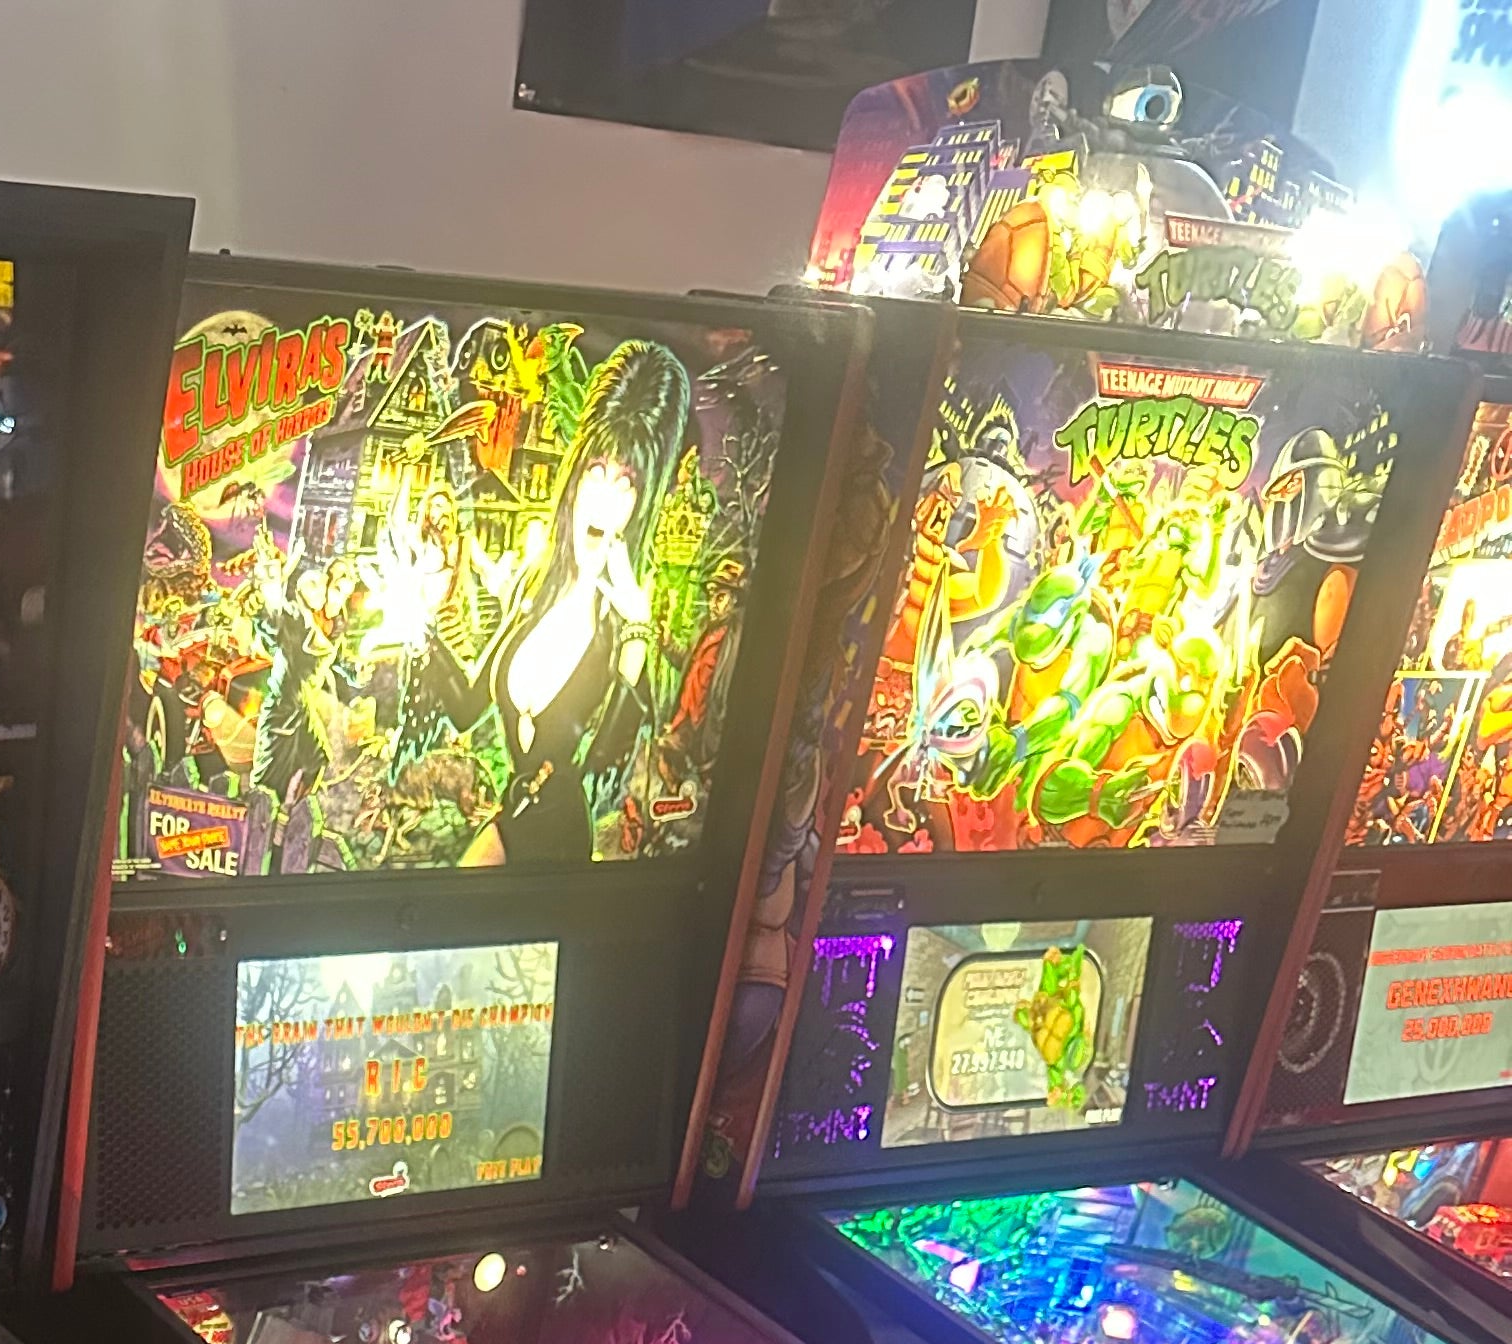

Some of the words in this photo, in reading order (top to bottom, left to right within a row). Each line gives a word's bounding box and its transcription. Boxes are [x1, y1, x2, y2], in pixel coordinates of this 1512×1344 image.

[164, 318, 350, 464] ELVIRA'S
[1100, 367, 1165, 394] TEENAGE
[1163, 373, 1214, 399] MUTANT
[1213, 380, 1256, 403] NINJA
[182, 434, 248, 499] HOUSE
[251, 424, 272, 459] OF
[275, 398, 332, 446] HORRORS
[1055, 396, 1260, 494] TURTLES
[149, 811, 191, 837] FOR
[185, 848, 239, 877] SALE
[272, 1018, 318, 1044] BRAIN
[325, 1016, 366, 1040] THAT
[331, 1113, 454, 1151] 55,700,000
